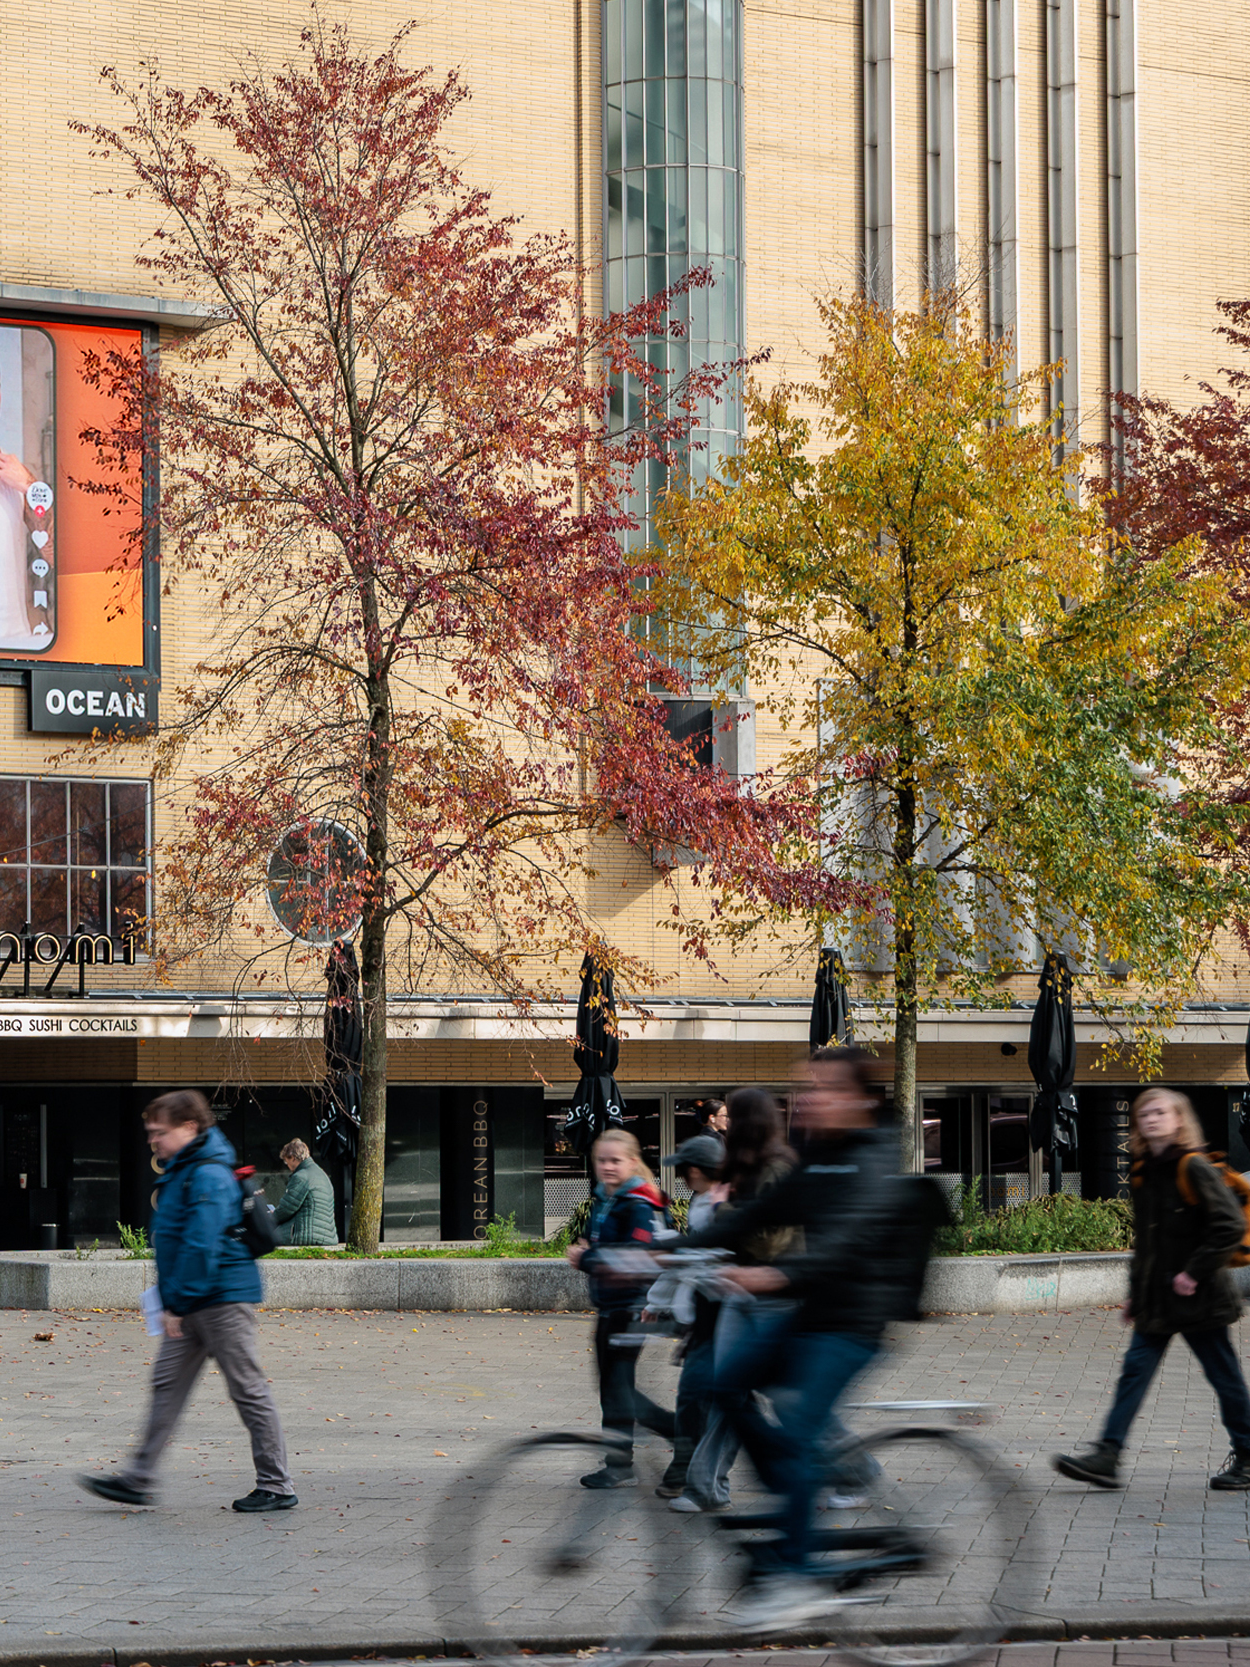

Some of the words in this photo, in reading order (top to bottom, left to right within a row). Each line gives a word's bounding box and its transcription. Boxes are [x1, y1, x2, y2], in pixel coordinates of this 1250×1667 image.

[45, 688, 146, 718] OCEAN
[29, 1019, 63, 1033] SUSHI
[68, 1018, 139, 1033] COCKTAILS
[472, 1100, 489, 1148] BBQ
[473, 1157, 488, 1240] OREAN
